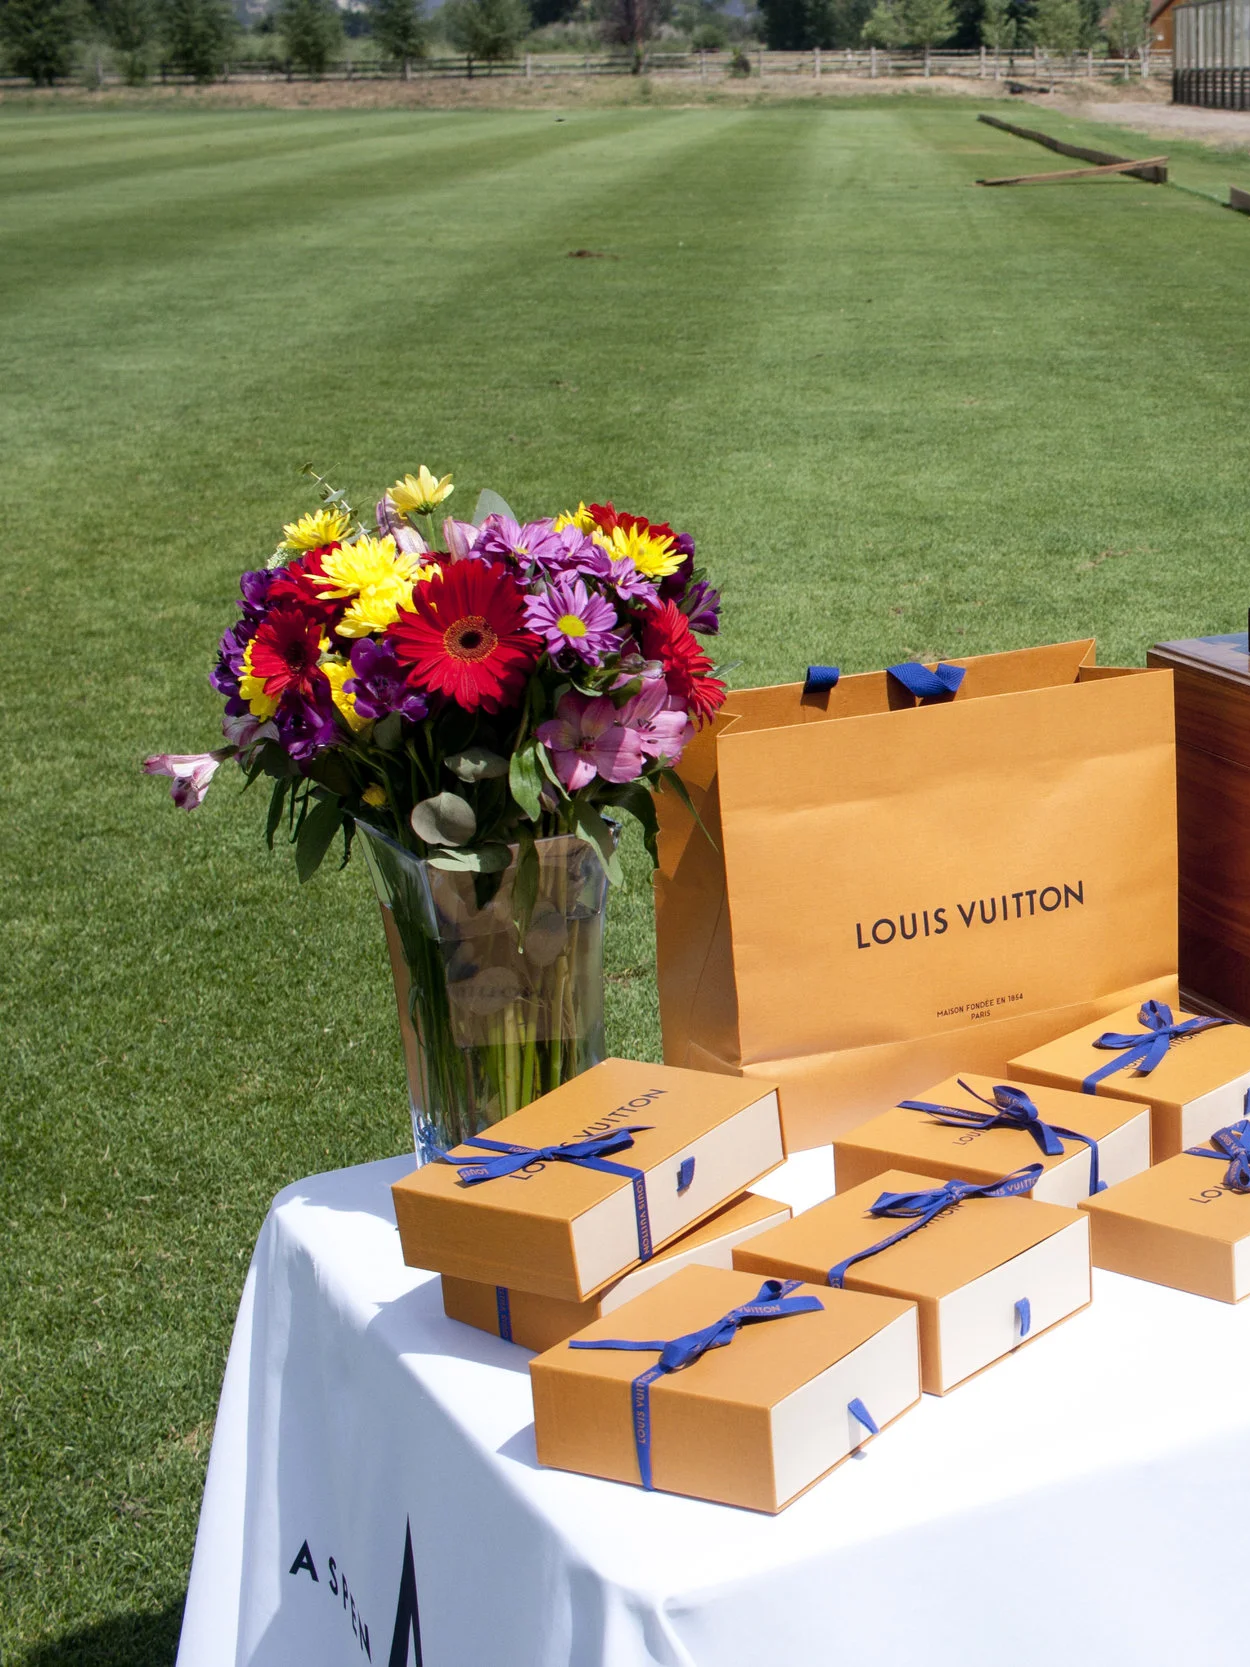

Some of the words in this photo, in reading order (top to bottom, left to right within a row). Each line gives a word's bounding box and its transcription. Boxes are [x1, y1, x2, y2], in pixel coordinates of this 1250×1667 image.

[856, 907, 949, 949] LOUIS
[956, 880, 1085, 929] VUITTON
[936, 1006, 964, 1018] MAISON
[996, 996, 1006, 1005] EN
[1008, 992, 1024, 1003] 1854
[970, 1010, 991, 1020] PARIS
[573, 1088, 669, 1138] VUITTON
[636, 1180, 645, 1210] LOUIS
[640, 1210, 650, 1255] VUITTON
[635, 1370, 658, 1408] VUITTON
[637, 1411, 646, 1443] LOUIS
[289, 1539, 371, 1664] ASPEN
